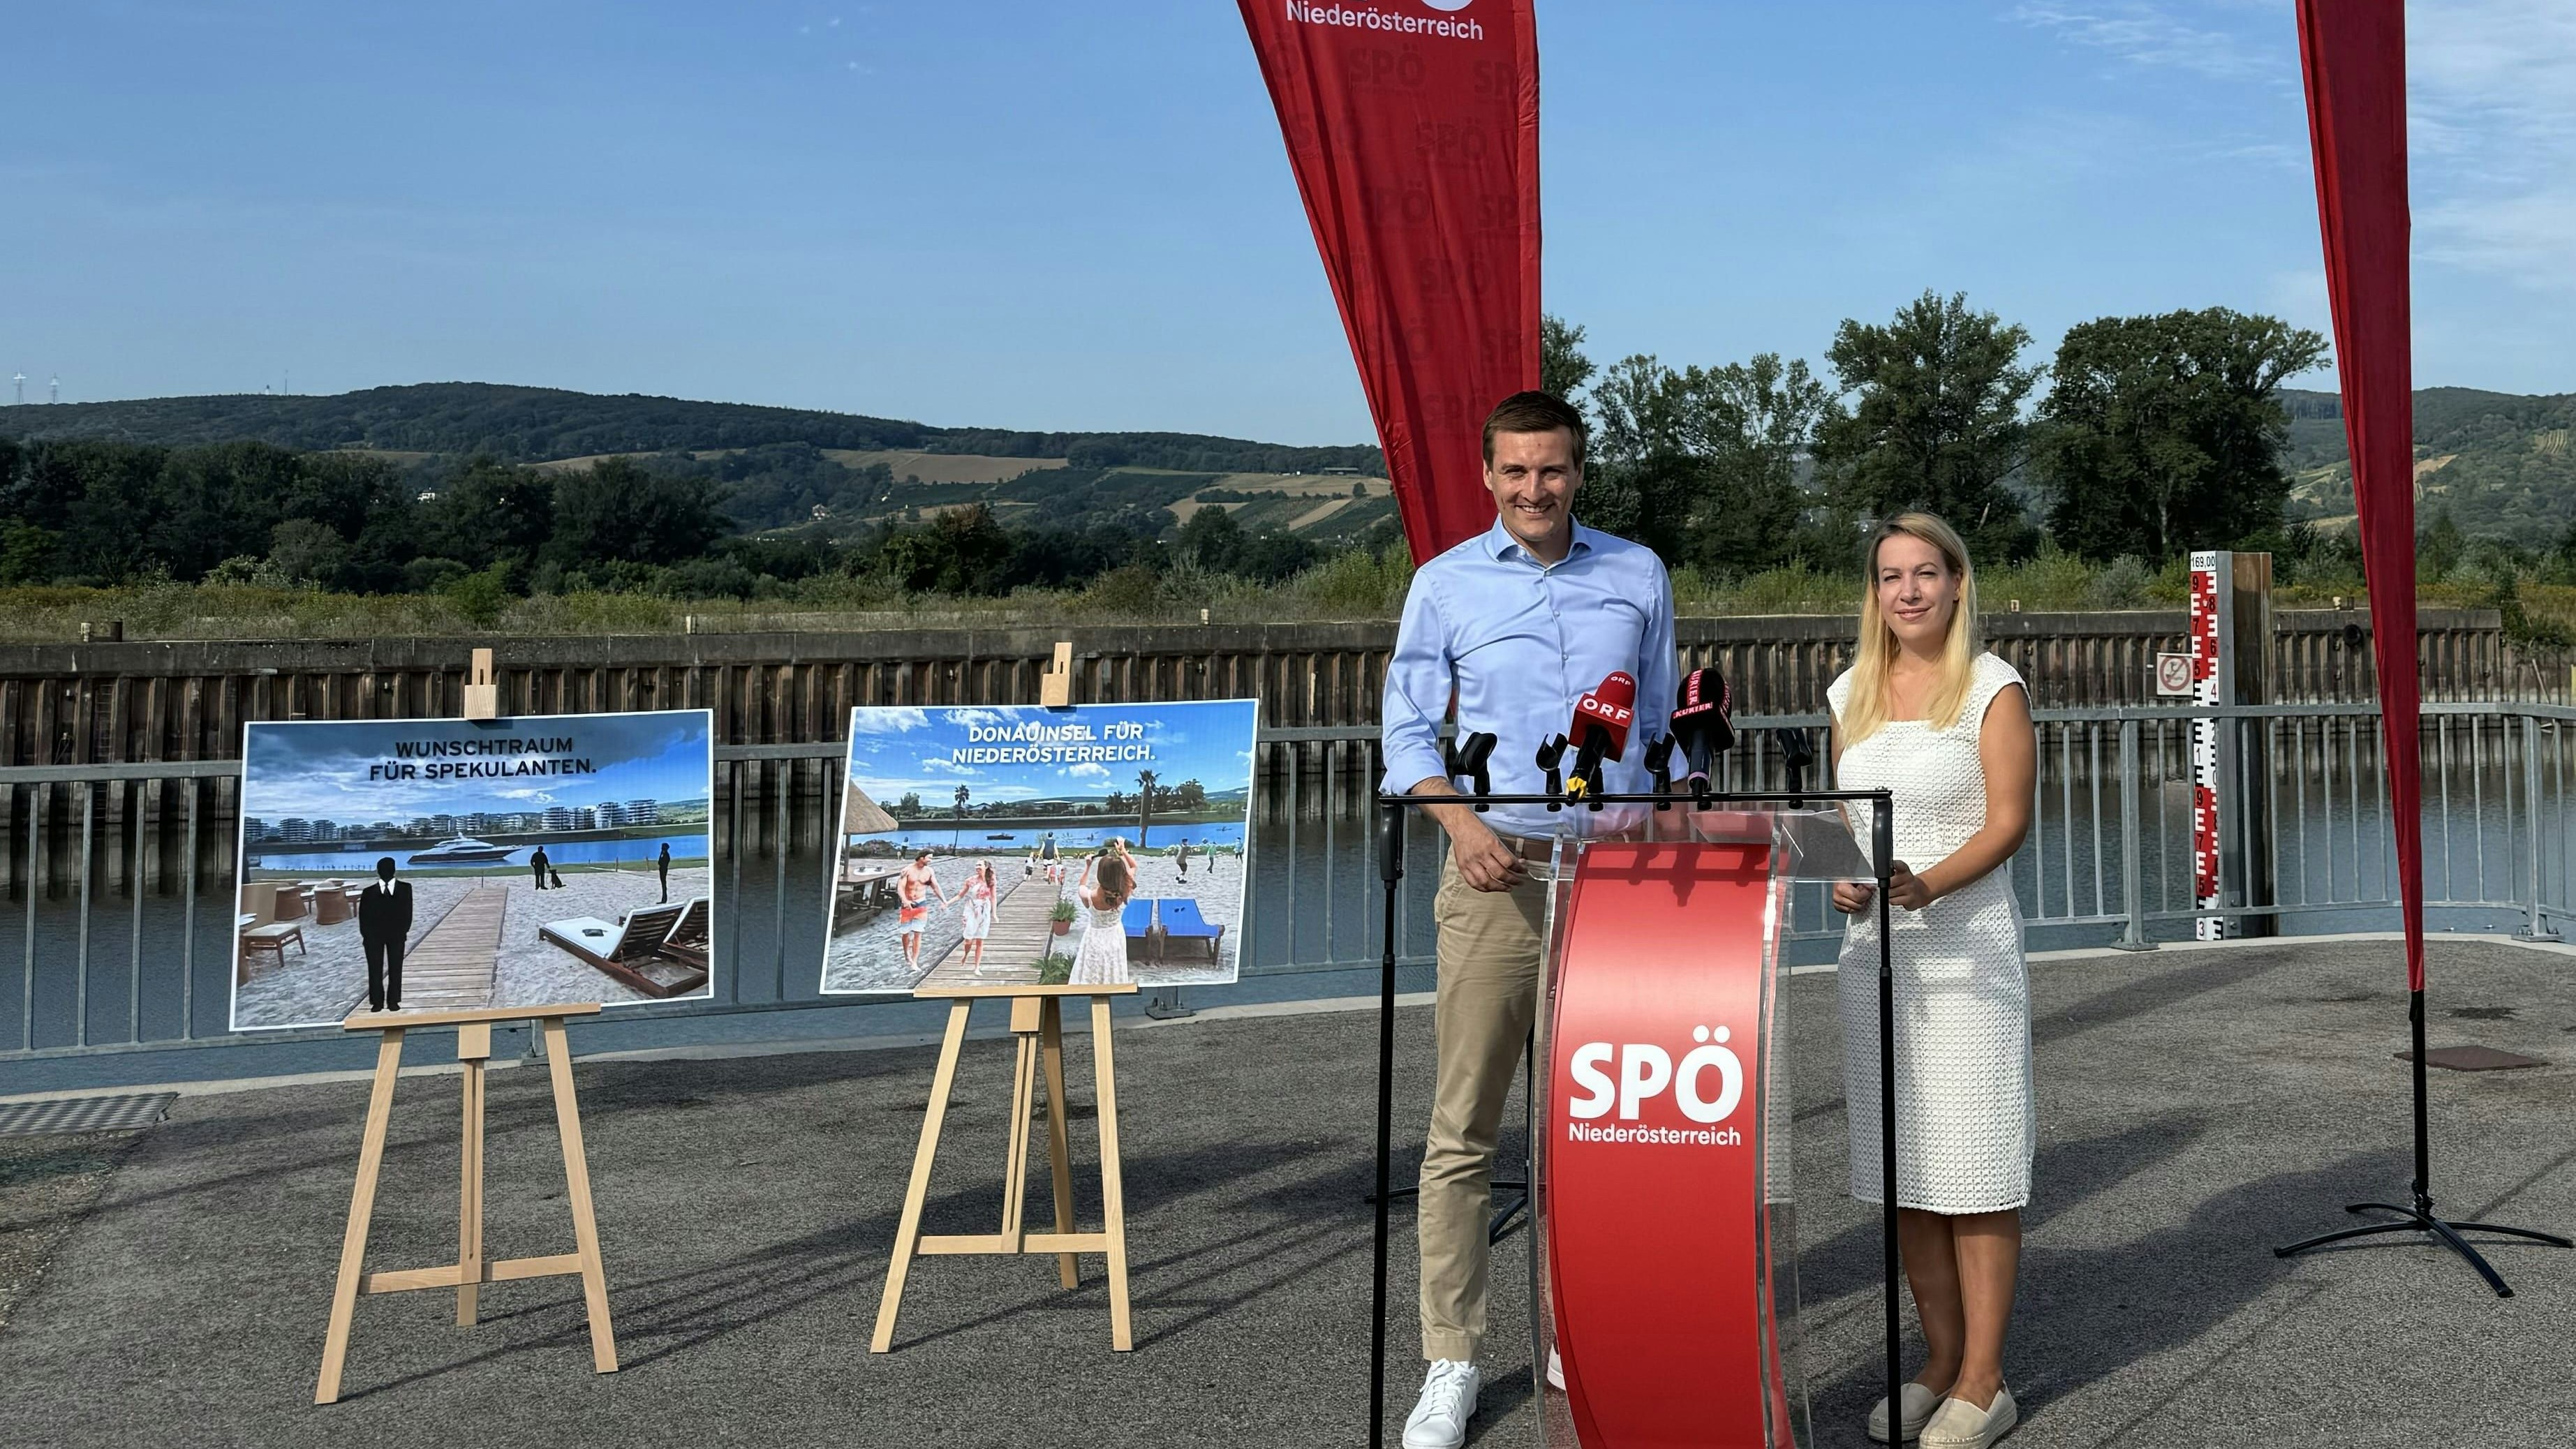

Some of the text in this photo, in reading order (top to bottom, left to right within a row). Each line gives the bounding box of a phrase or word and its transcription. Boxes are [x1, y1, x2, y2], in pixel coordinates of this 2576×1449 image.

[1285, 0, 1483, 40] Niederösterreich
[1473, 59, 1518, 96] SP
[2191, 556, 2216, 568] 169,00
[2193, 575, 2199, 590] 9
[2209, 595, 2216, 612] 8
[2193, 618, 2200, 634] 7
[2210, 639, 2216, 655] 6
[2194, 661, 2201, 676] 5
[1611, 676, 1631, 685] ORF
[2211, 683, 2217, 698] 4
[1583, 698, 1631, 720] ORF
[1673, 701, 1713, 719] KURIER
[969, 721, 1143, 743] DONAUINSEL FÜR
[395, 737, 572, 758] WUNSCHTRAUM
[952, 744, 1156, 764] NIEDERÖSTERREICH.
[2196, 747, 2200, 762] 1
[370, 758, 597, 781] FÜR SPEKULANTEN.
[2196, 789, 2203, 805] 9
[2197, 833, 2204, 849] 7
[2198, 877, 2205, 893] 5
[2199, 921, 2205, 936] 3
[1569, 1025, 1744, 1123] SPÖ
[1569, 1122, 1741, 1145] Niederösterreich
